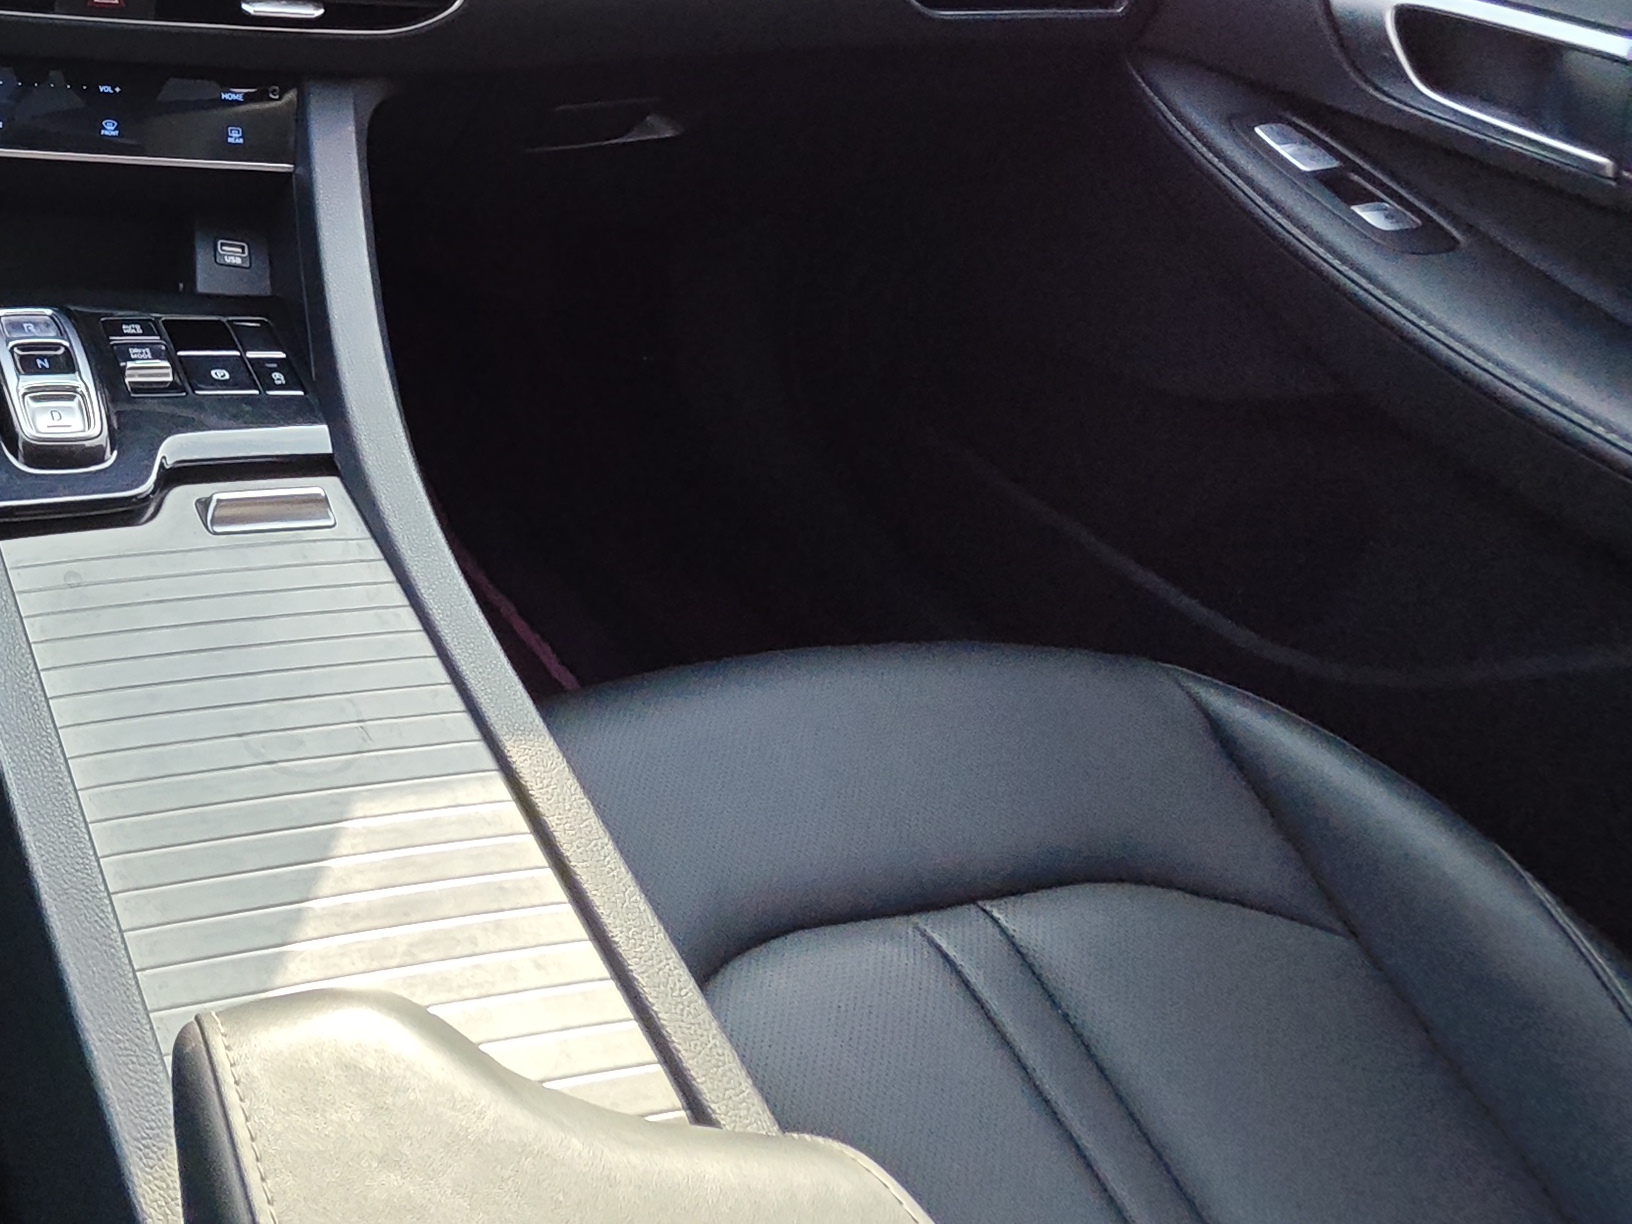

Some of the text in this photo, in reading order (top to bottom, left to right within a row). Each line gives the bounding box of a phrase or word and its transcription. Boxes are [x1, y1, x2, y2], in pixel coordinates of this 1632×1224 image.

[221, 92, 245, 101] HOME
[224, 255, 242, 264] USB
[23, 323, 35, 333] R
[35, 357, 50, 369] N
[51, 410, 62, 422] D
